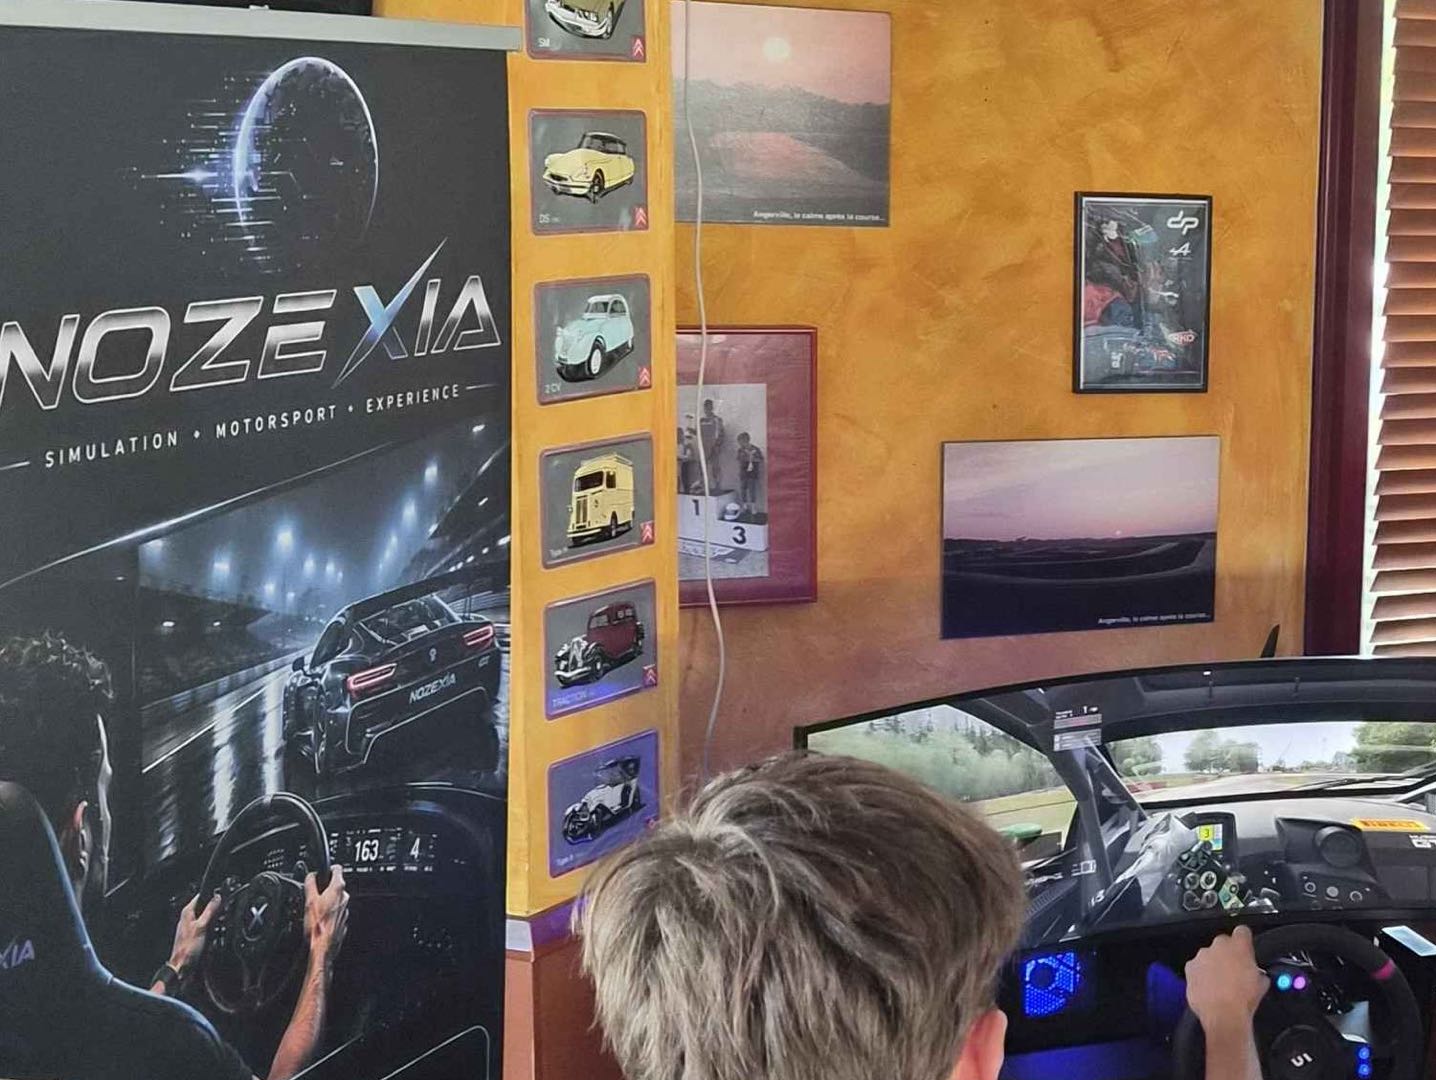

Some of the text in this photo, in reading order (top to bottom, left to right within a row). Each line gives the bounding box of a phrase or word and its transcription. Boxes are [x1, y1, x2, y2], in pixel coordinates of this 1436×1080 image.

[0, 237, 502, 410] NOZEXIA
[45, 384, 461, 469] SIMULATION MOTORSPORT EXPERIENCE
[732, 526, 747, 545] 3
[409, 672, 457, 704] NOZEXIA
[355, 836, 422, 863] 163 4
